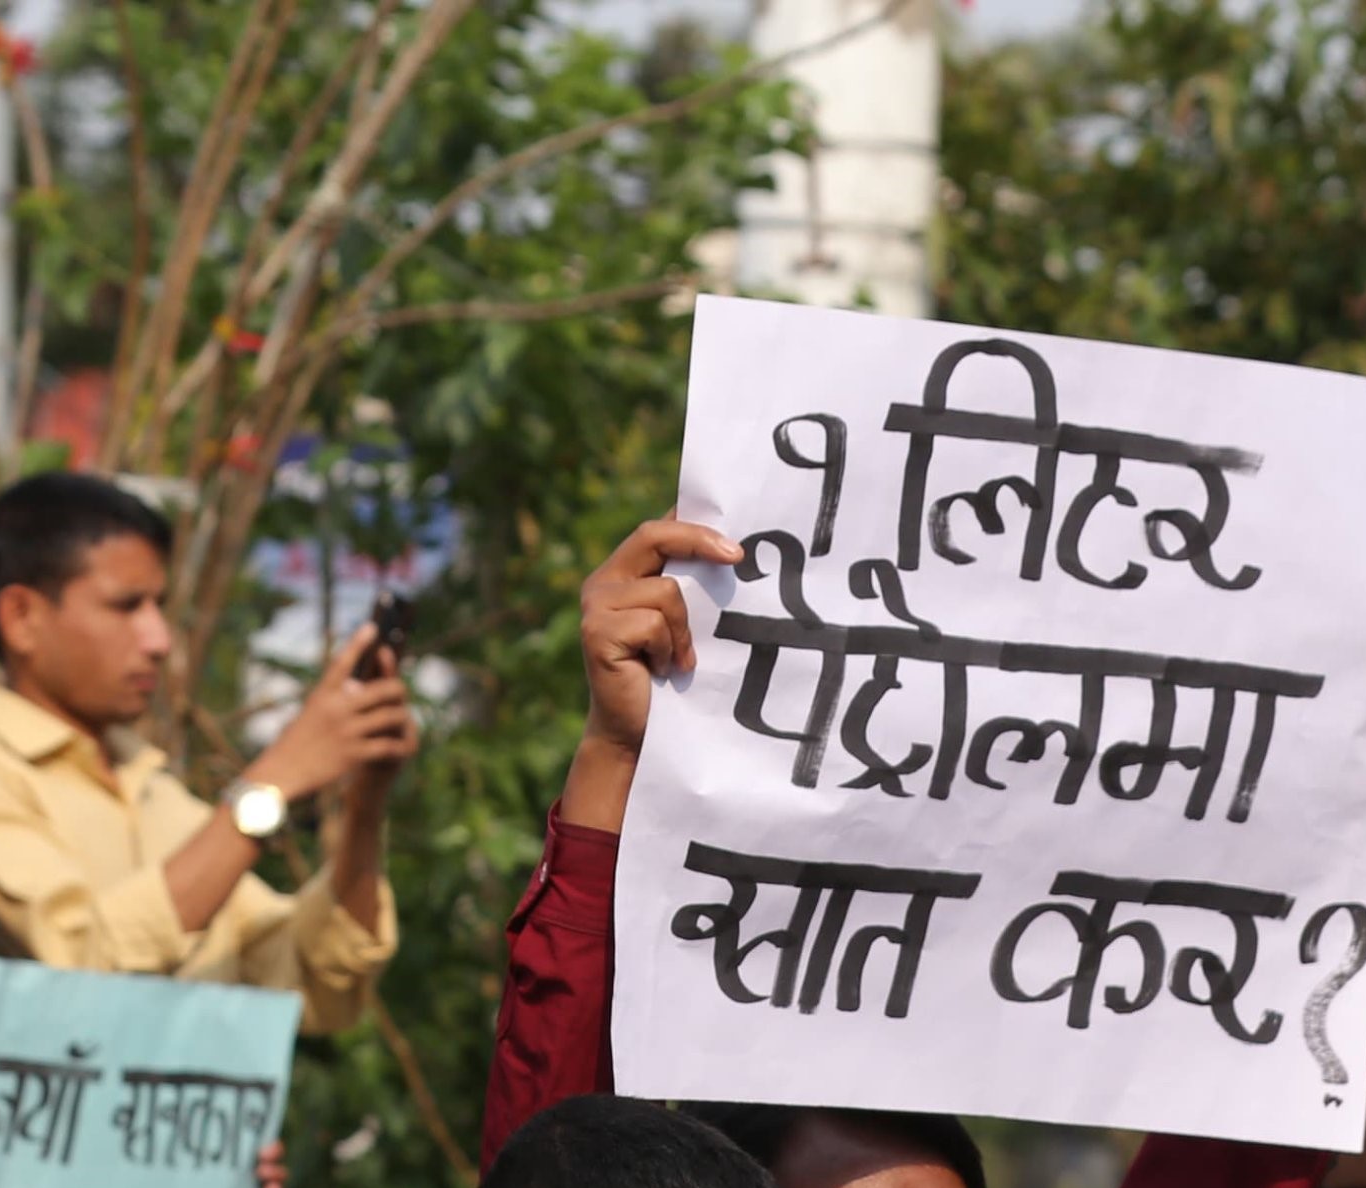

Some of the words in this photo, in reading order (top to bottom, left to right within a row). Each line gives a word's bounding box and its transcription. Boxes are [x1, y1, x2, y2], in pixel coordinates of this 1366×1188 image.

[772, 413, 847, 557] १
[884, 338, 1264, 591] लिटर
[671, 841, 982, 1018] सात
